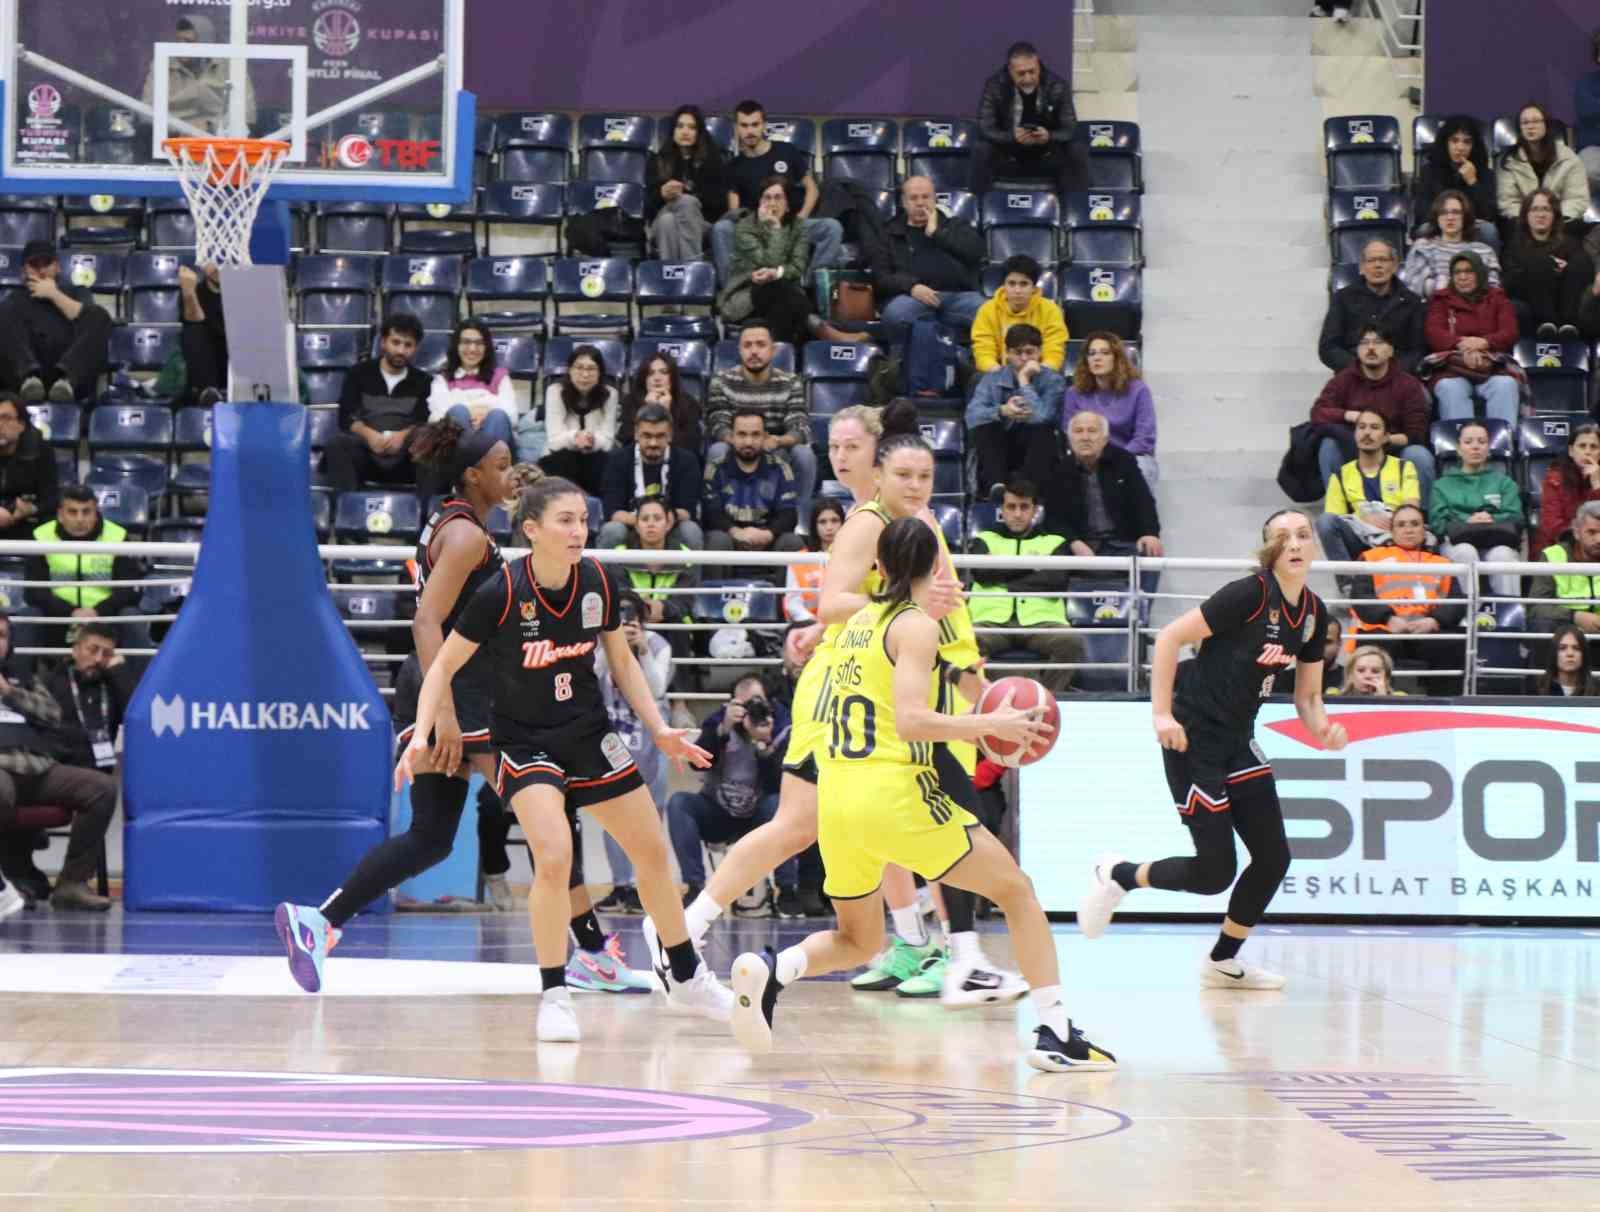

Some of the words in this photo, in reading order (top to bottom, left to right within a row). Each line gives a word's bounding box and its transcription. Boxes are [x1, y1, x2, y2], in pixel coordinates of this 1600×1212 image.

[375, 138, 440, 167] TBF
[553, 672, 574, 702] 8
[191, 701, 371, 730] HALKBANK
[829, 694, 876, 759] 10
[1266, 757, 1600, 863] SPO
[1280, 874, 1430, 899] EŞKİLAT
[1451, 876, 1594, 901] BAŞKAN
